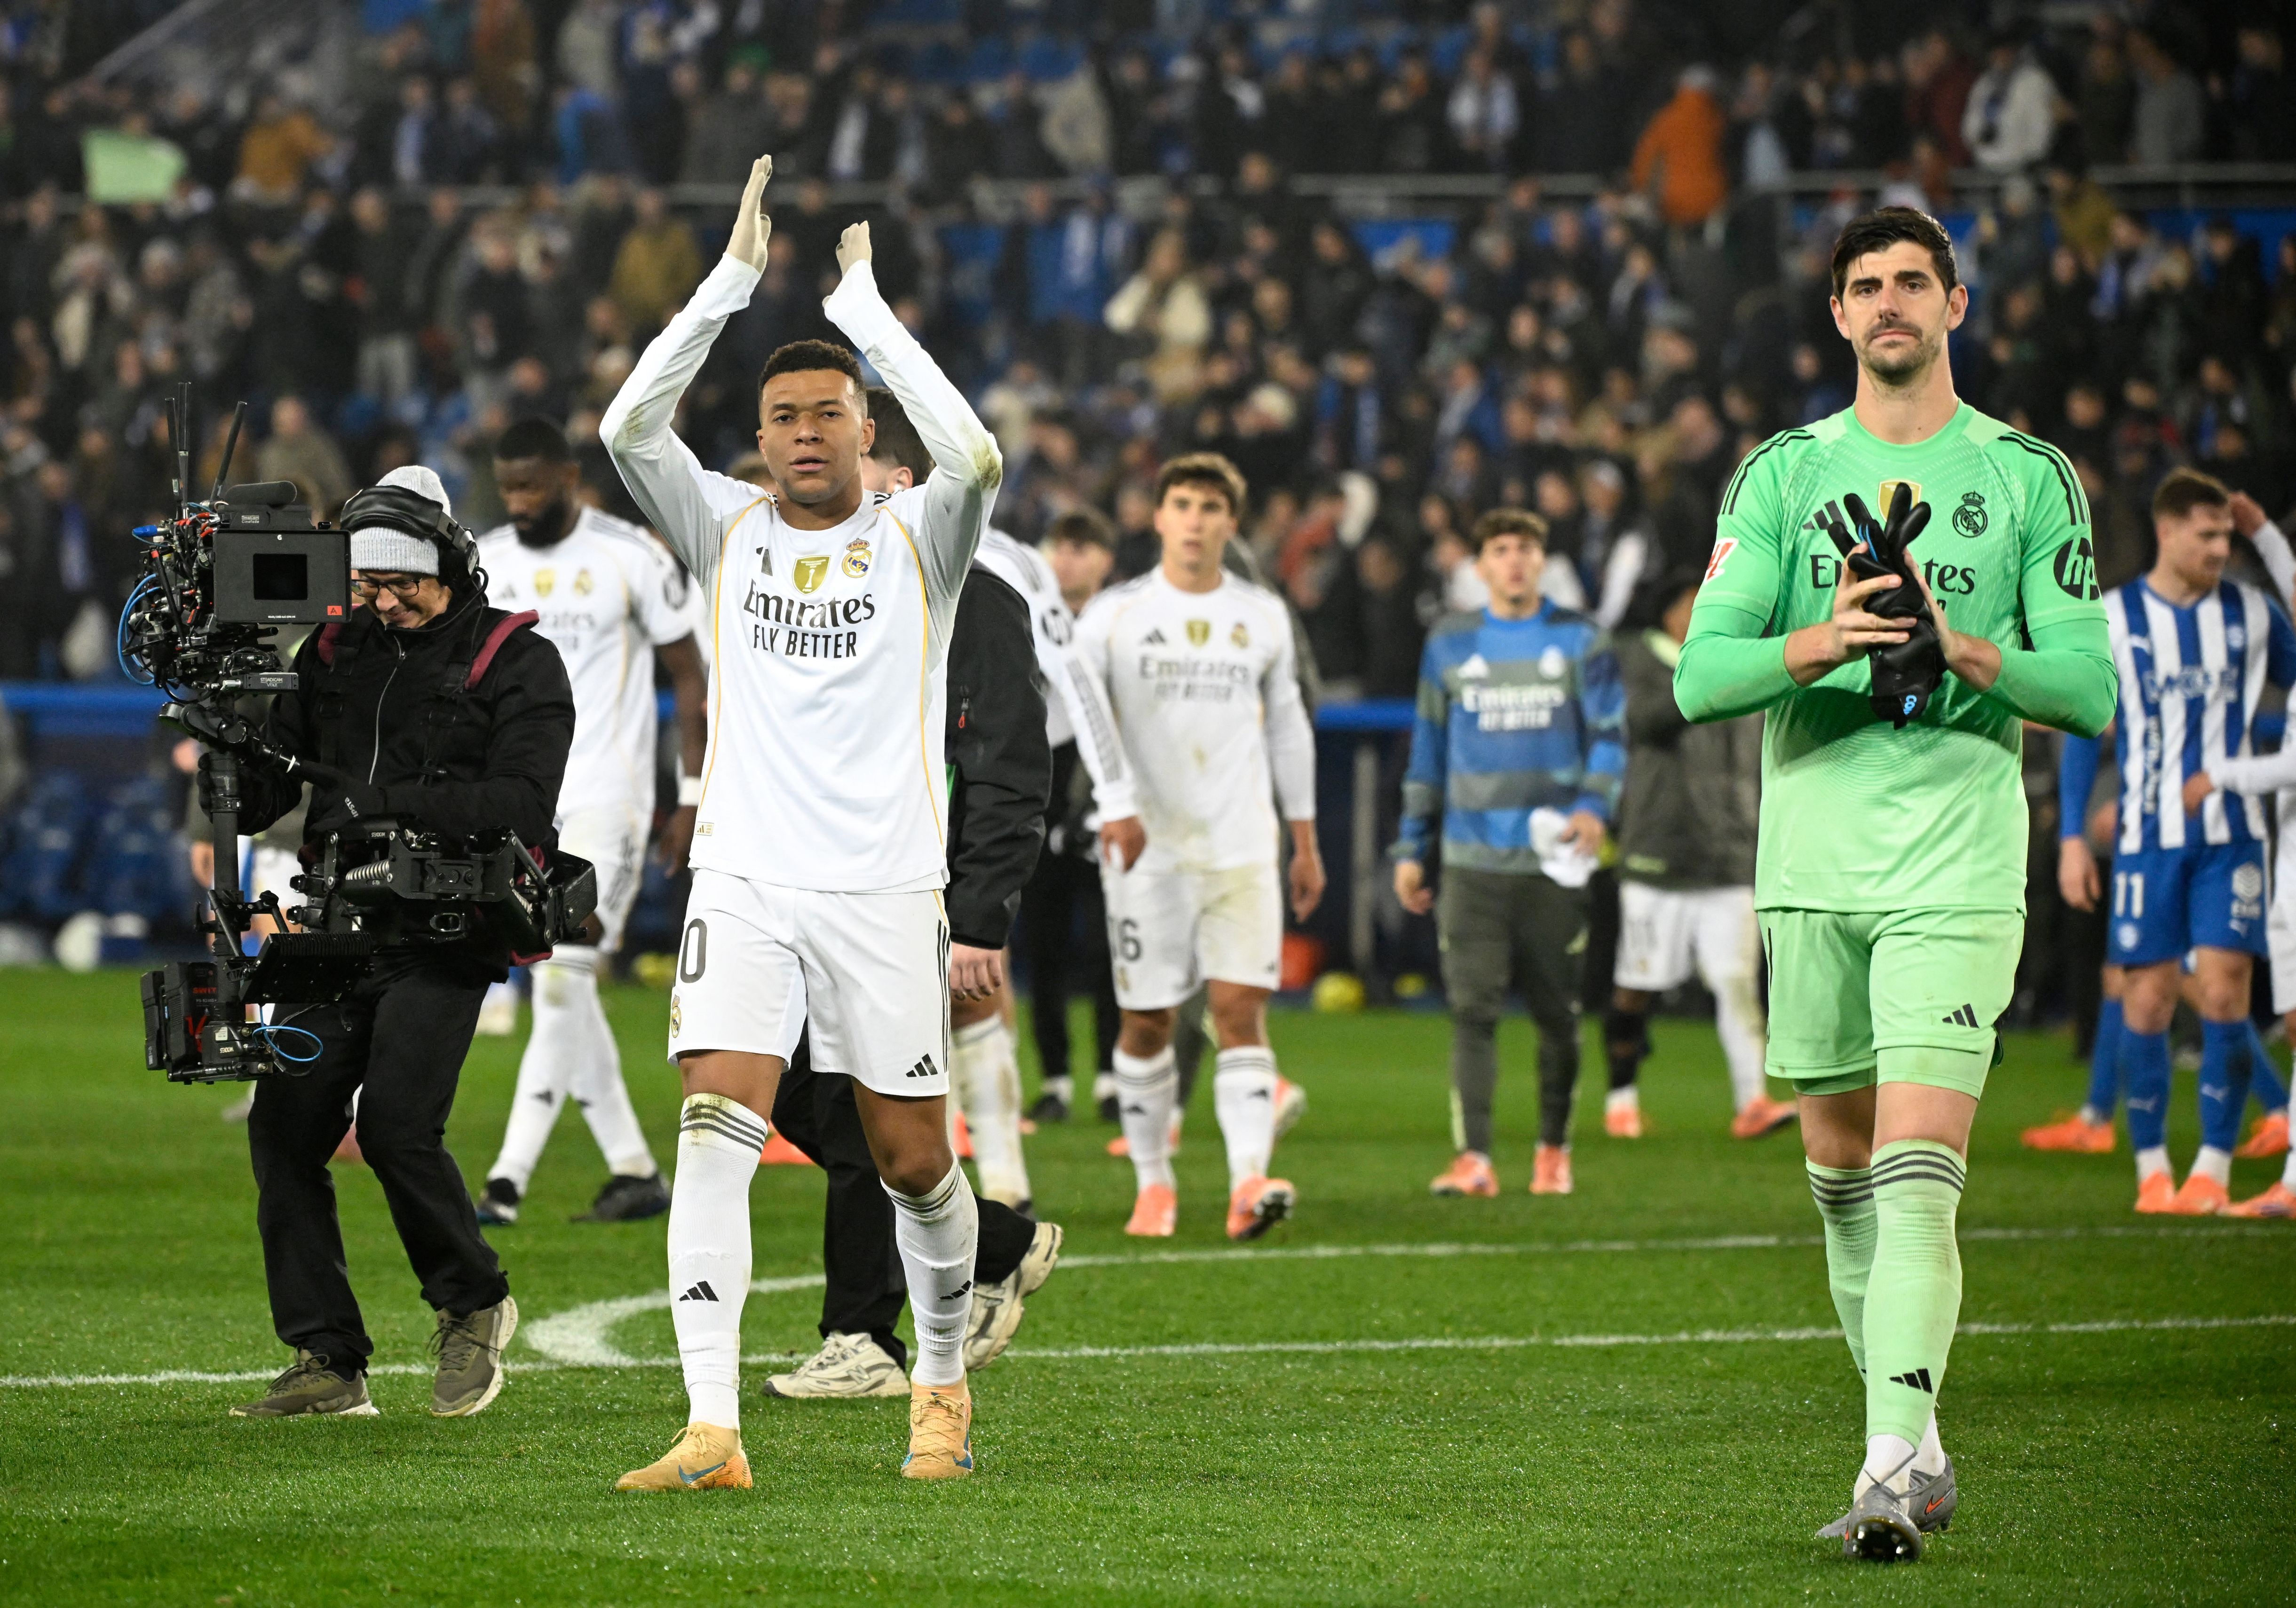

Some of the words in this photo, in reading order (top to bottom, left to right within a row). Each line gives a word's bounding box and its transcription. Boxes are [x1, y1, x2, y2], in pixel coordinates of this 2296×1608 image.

[1810, 554, 1976, 595] Etes
[2062, 537, 2098, 600] hp
[744, 578, 875, 628] Emirates
[753, 624, 779, 653] FLY
[785, 631, 856, 658] BETTER
[2115, 872, 2144, 919] 11
[673, 918, 707, 984] 0
